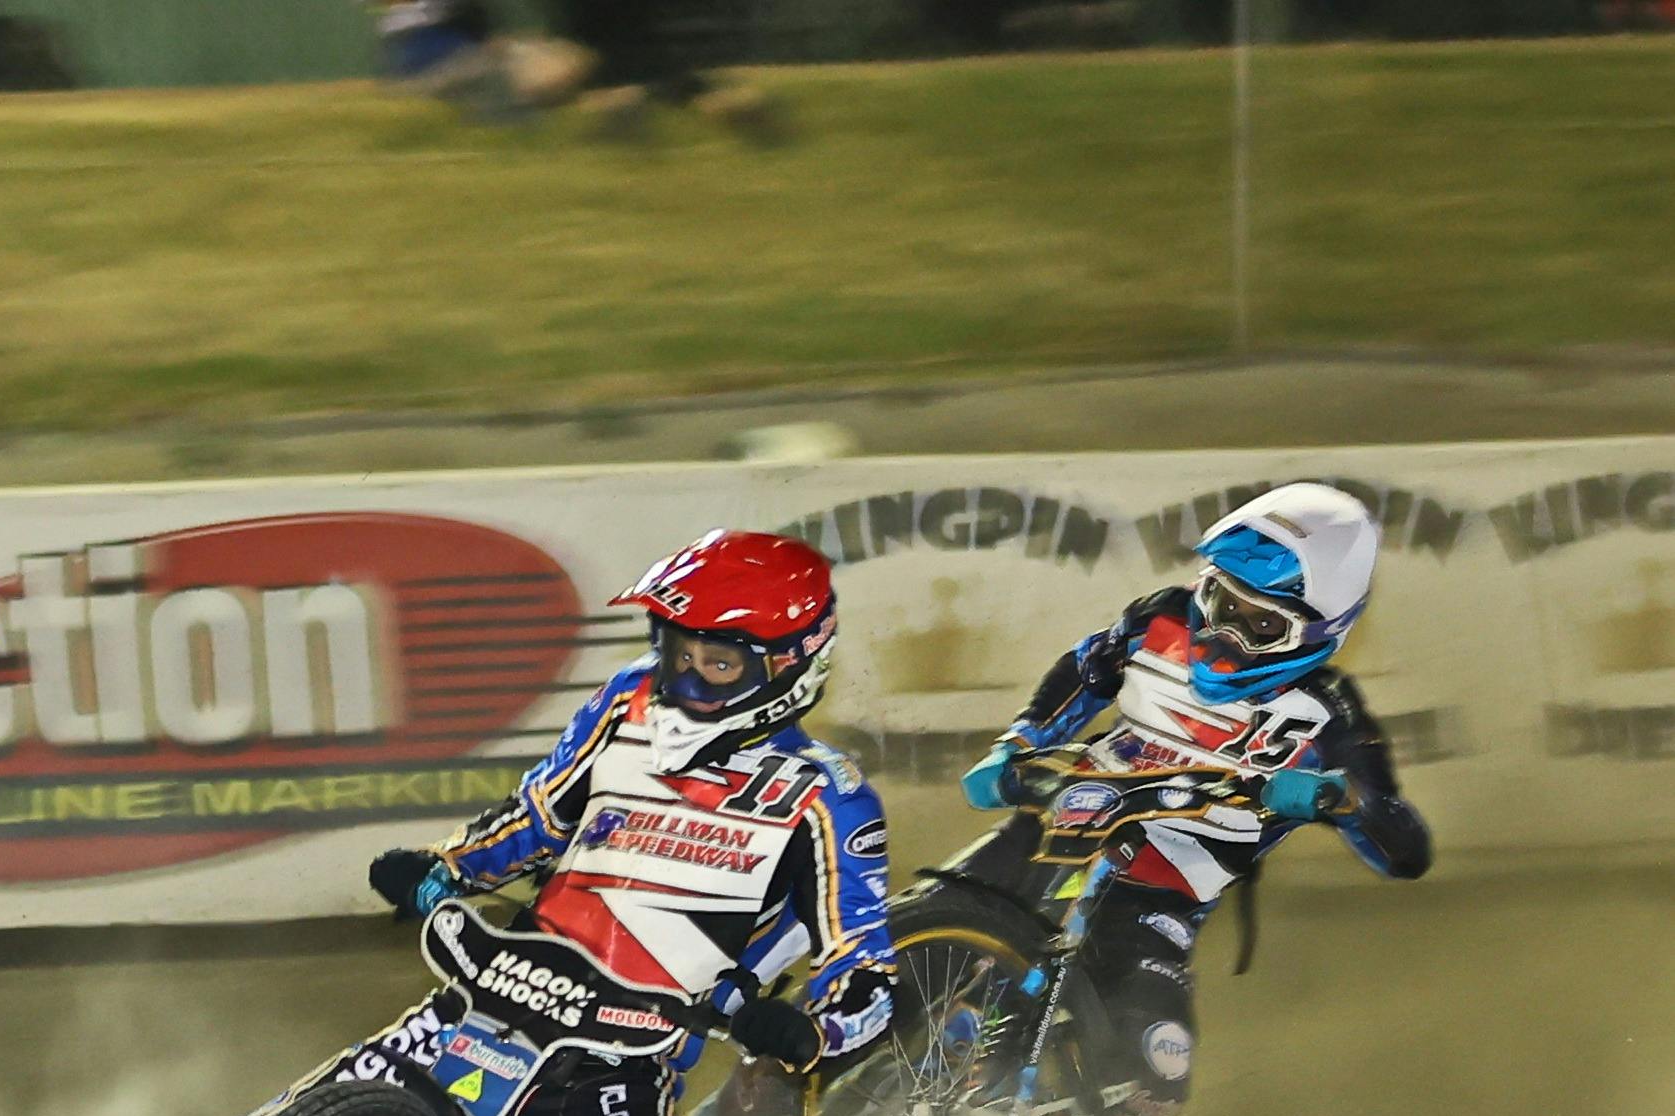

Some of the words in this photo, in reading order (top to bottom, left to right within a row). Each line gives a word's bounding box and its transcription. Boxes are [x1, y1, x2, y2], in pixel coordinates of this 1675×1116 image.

[1134, 476, 1464, 575] KIIN
[1214, 708, 1322, 768] 15
[723, 753, 822, 820] 11
[606, 830, 768, 875] SPEEDWAY
[626, 810, 755, 850] GILLMAN
[476, 968, 584, 1028] SHOCKS
[488, 950, 598, 1007] HAGON
